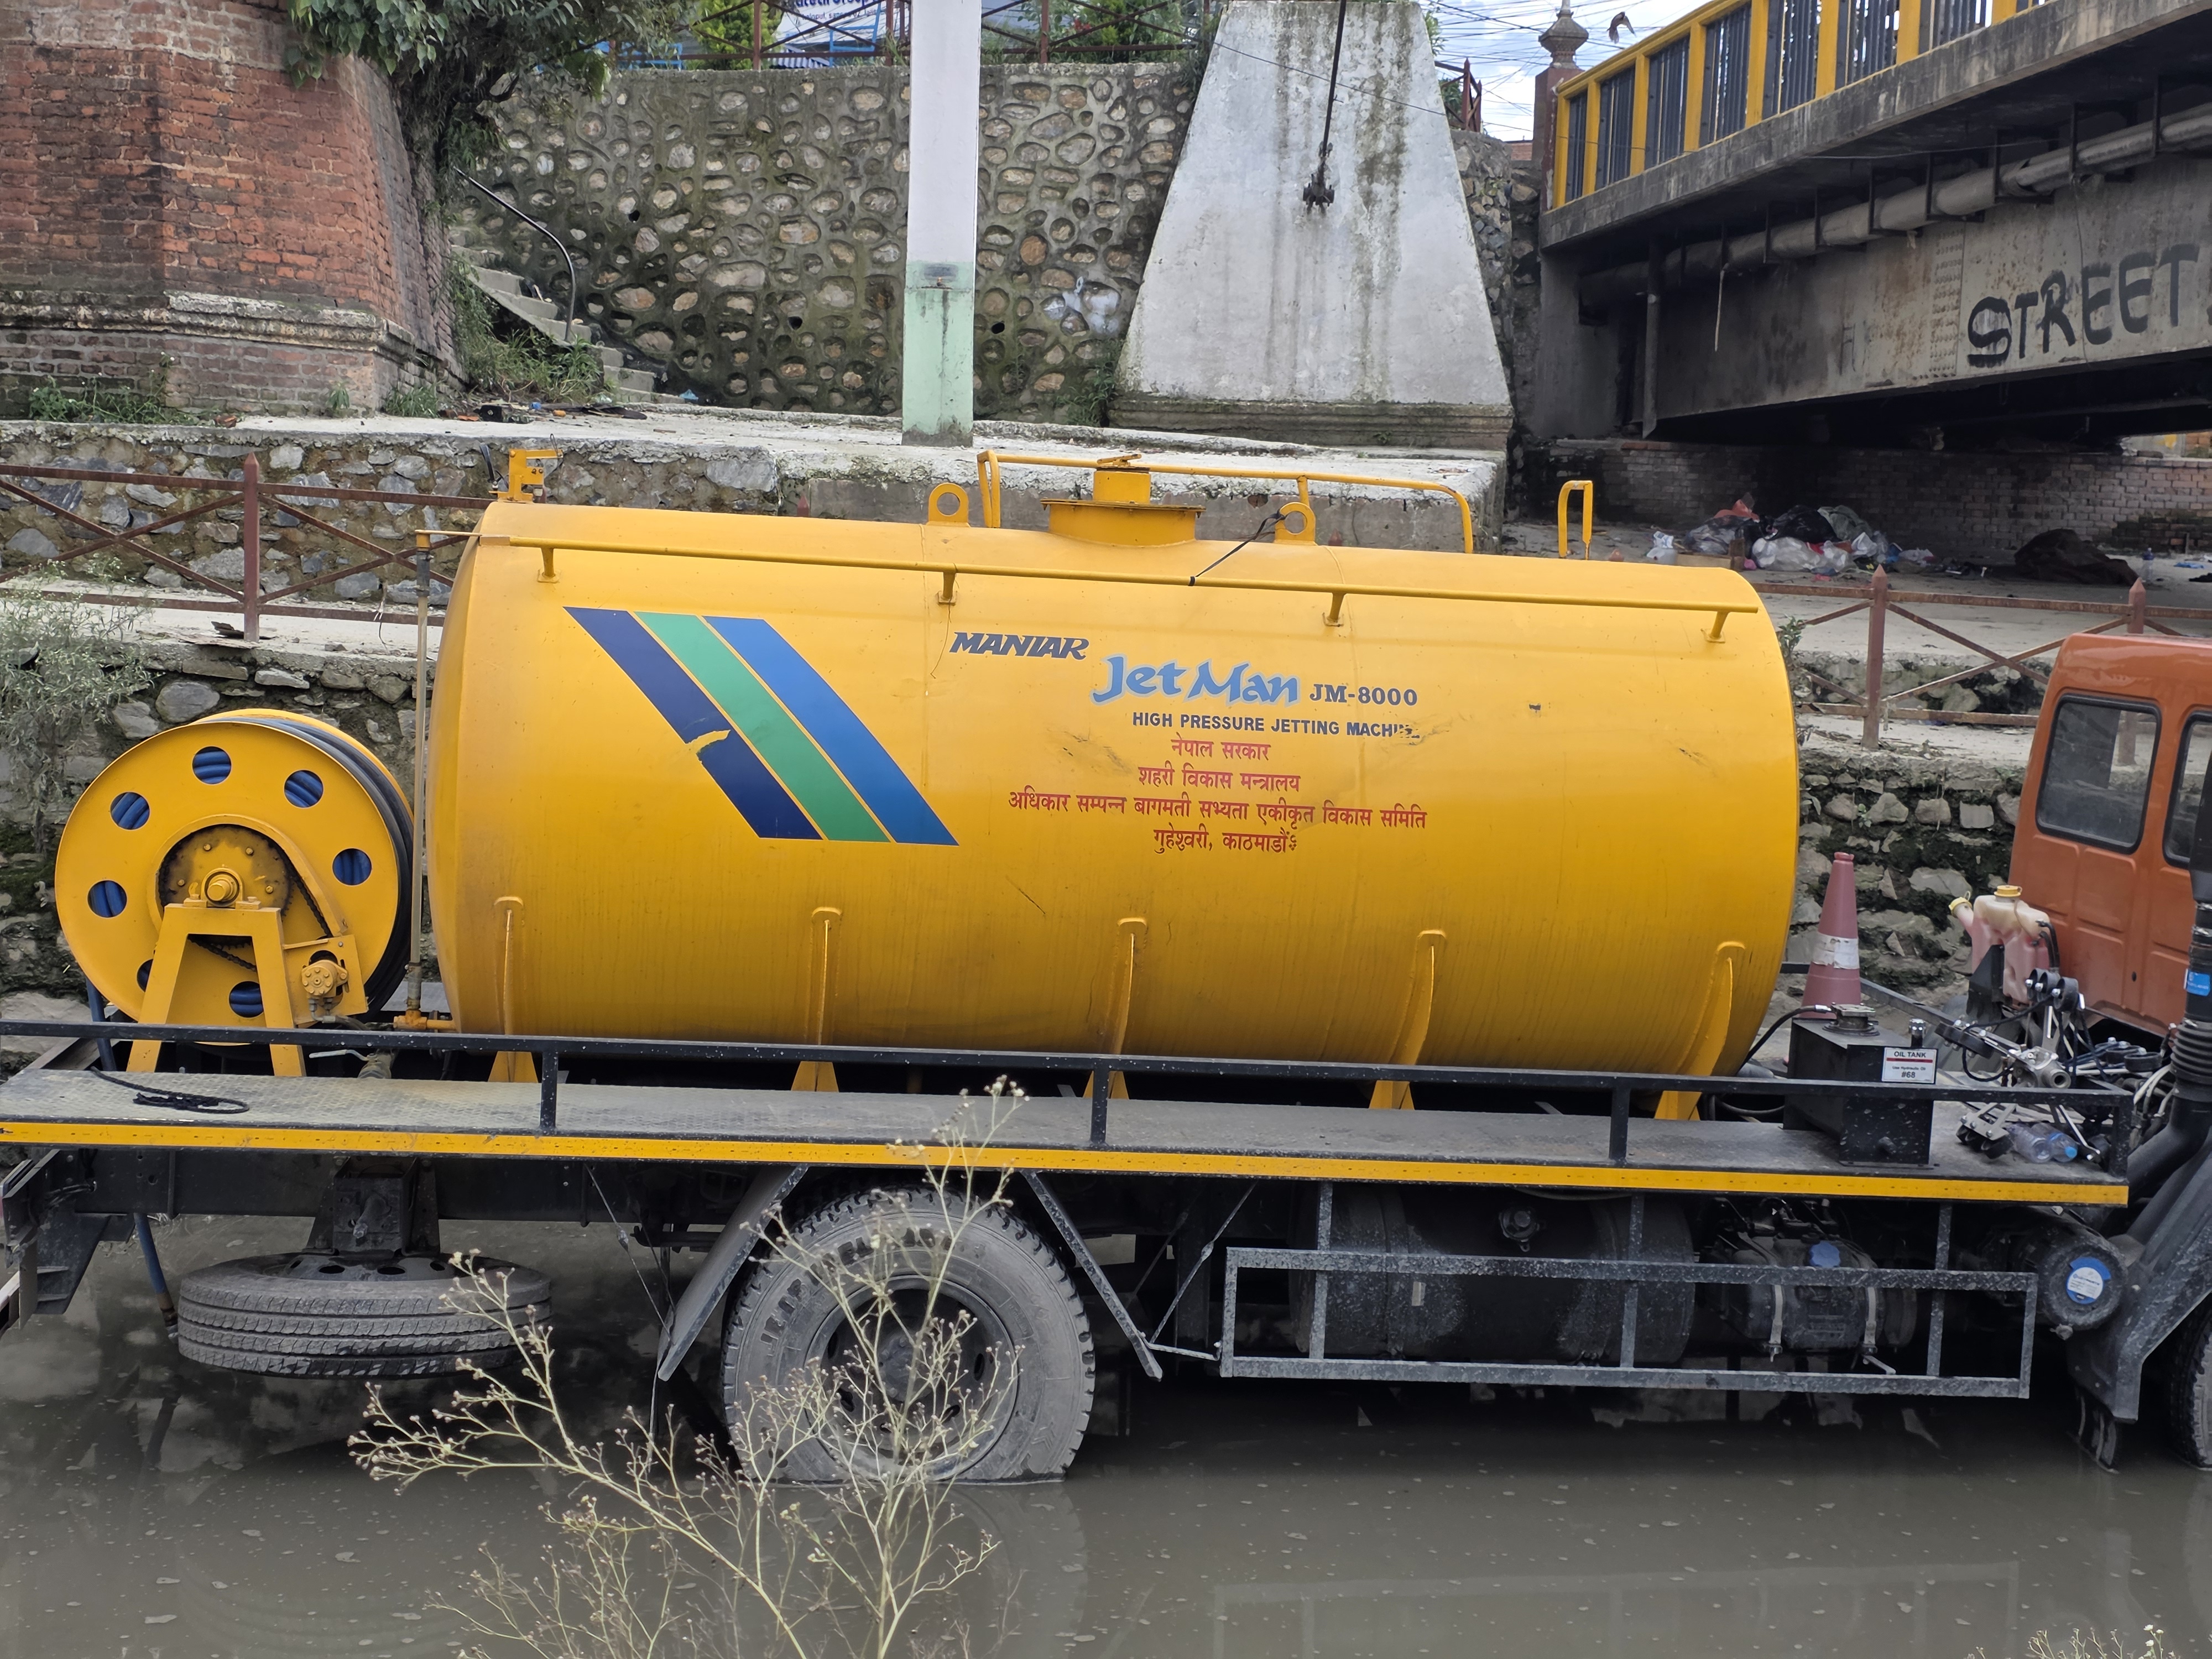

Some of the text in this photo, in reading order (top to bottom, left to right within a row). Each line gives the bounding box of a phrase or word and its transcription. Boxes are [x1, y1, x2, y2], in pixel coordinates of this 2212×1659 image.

[1967, 243, 2199, 368] STREET
[950, 632, 1089, 660] MANIAR
[1092, 655, 1418, 707] Jet Man JM-8000
[1133, 712, 1173, 728] HIGH
[1180, 714, 1265, 732] PRESSURE
[1271, 718, 1340, 735] JETTING
[1171, 732, 1271, 761] नेपाल सरकार
[1138, 760, 1301, 792] शहरी विकास मन्त्रालय
[1009, 785, 1428, 830] अधिकार सम्पन्न बागमती सभ्यता एकीकृत विकास समिति
